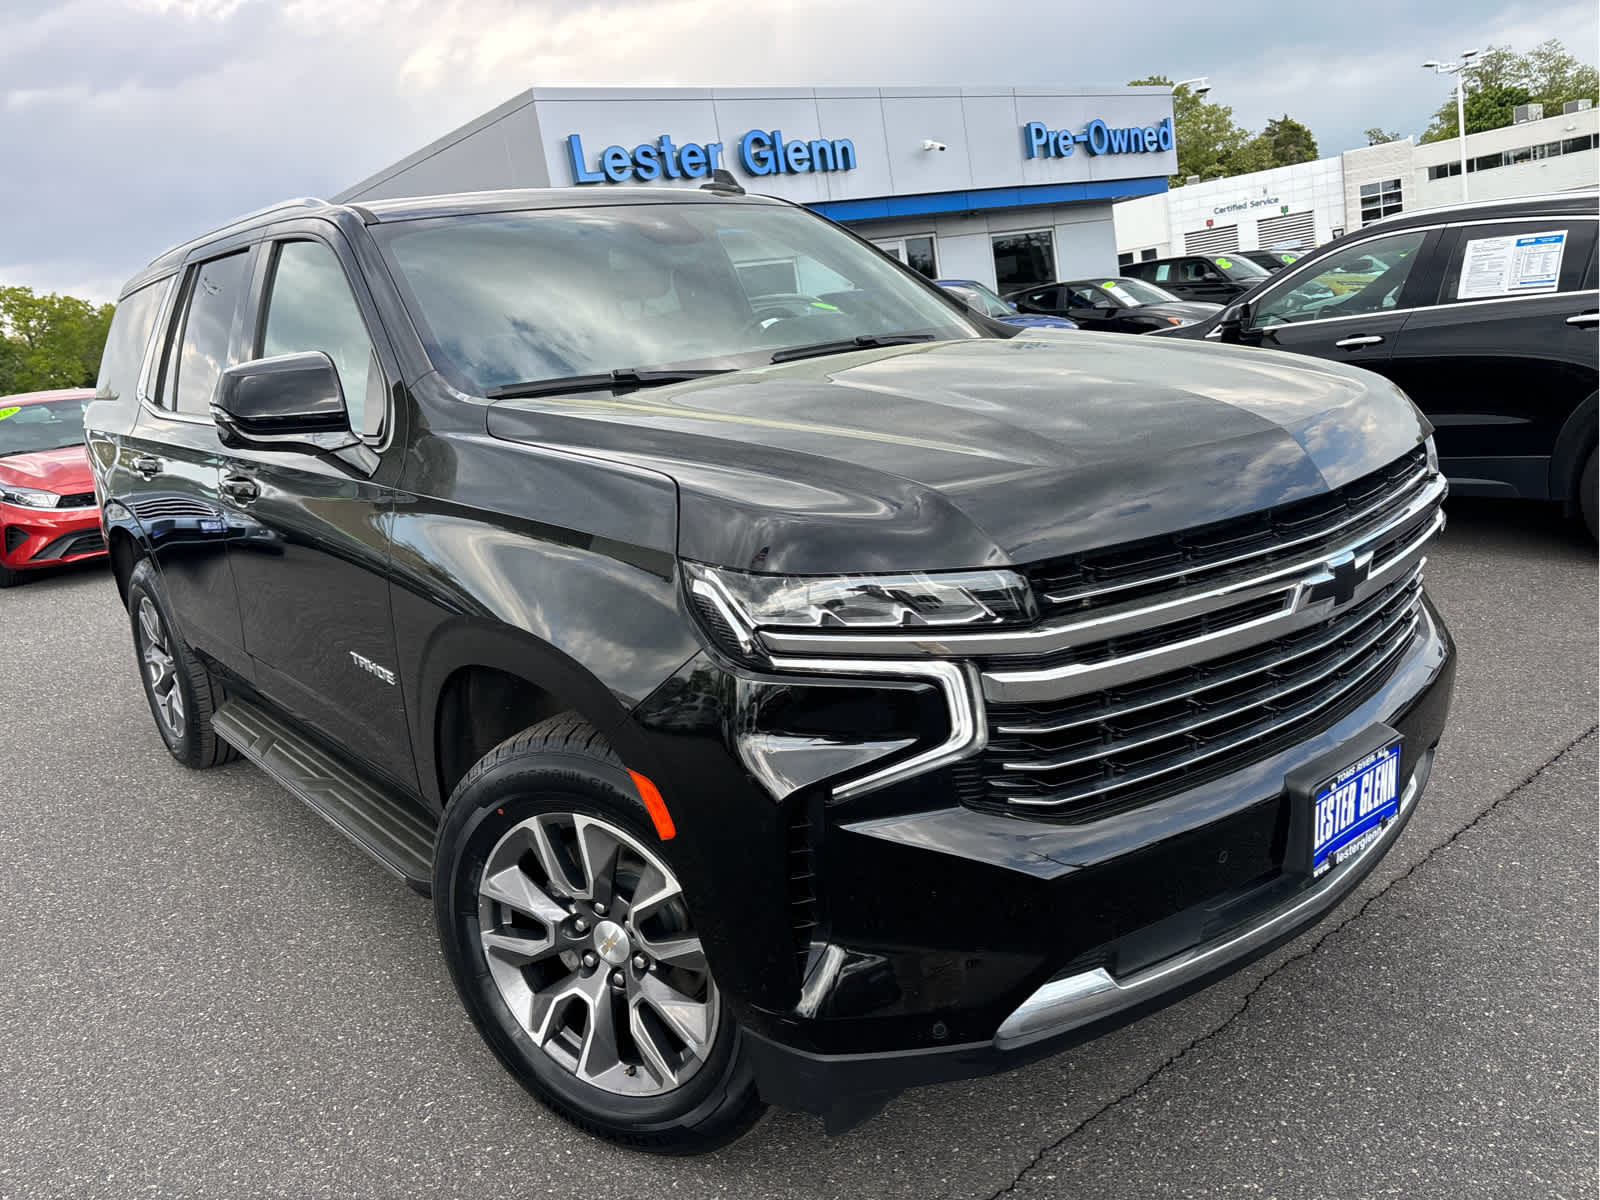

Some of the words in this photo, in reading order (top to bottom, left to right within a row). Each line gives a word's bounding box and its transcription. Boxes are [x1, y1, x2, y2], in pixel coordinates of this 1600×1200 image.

[566, 133, 723, 184] Lester
[737, 128, 857, 177] Glenn
[1024, 117, 1173, 159] Pre-Owned
[1213, 201, 1248, 215] Certified
[1249, 197, 1280, 208] Service
[349, 650, 396, 686] TAHOE
[1314, 781, 1357, 850] LESTER
[1359, 755, 1398, 817] GLENN
